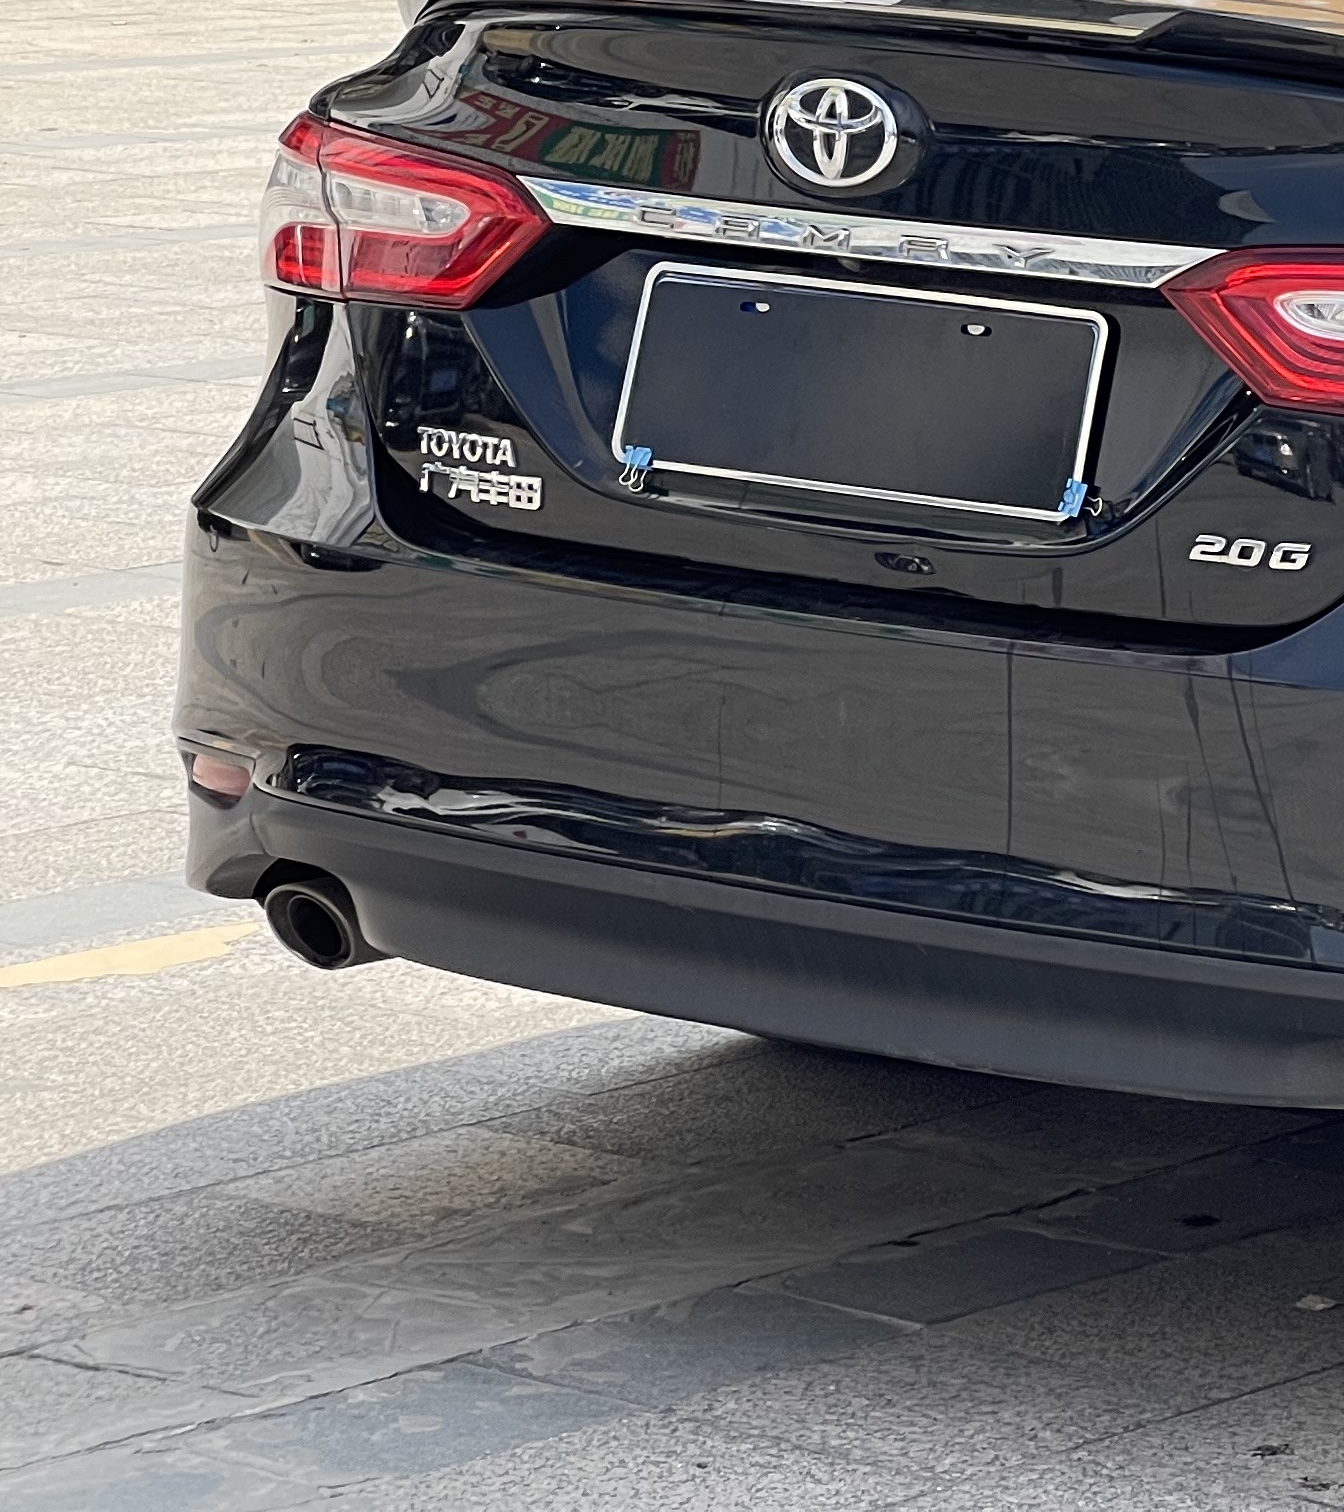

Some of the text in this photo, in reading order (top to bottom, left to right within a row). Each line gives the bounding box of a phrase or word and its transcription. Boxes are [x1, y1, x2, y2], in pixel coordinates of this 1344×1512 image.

[634, 202, 1055, 269] CAMRY
[417, 425, 517, 468] TOYOTA
[418, 461, 543, 511] 广汽丰田
